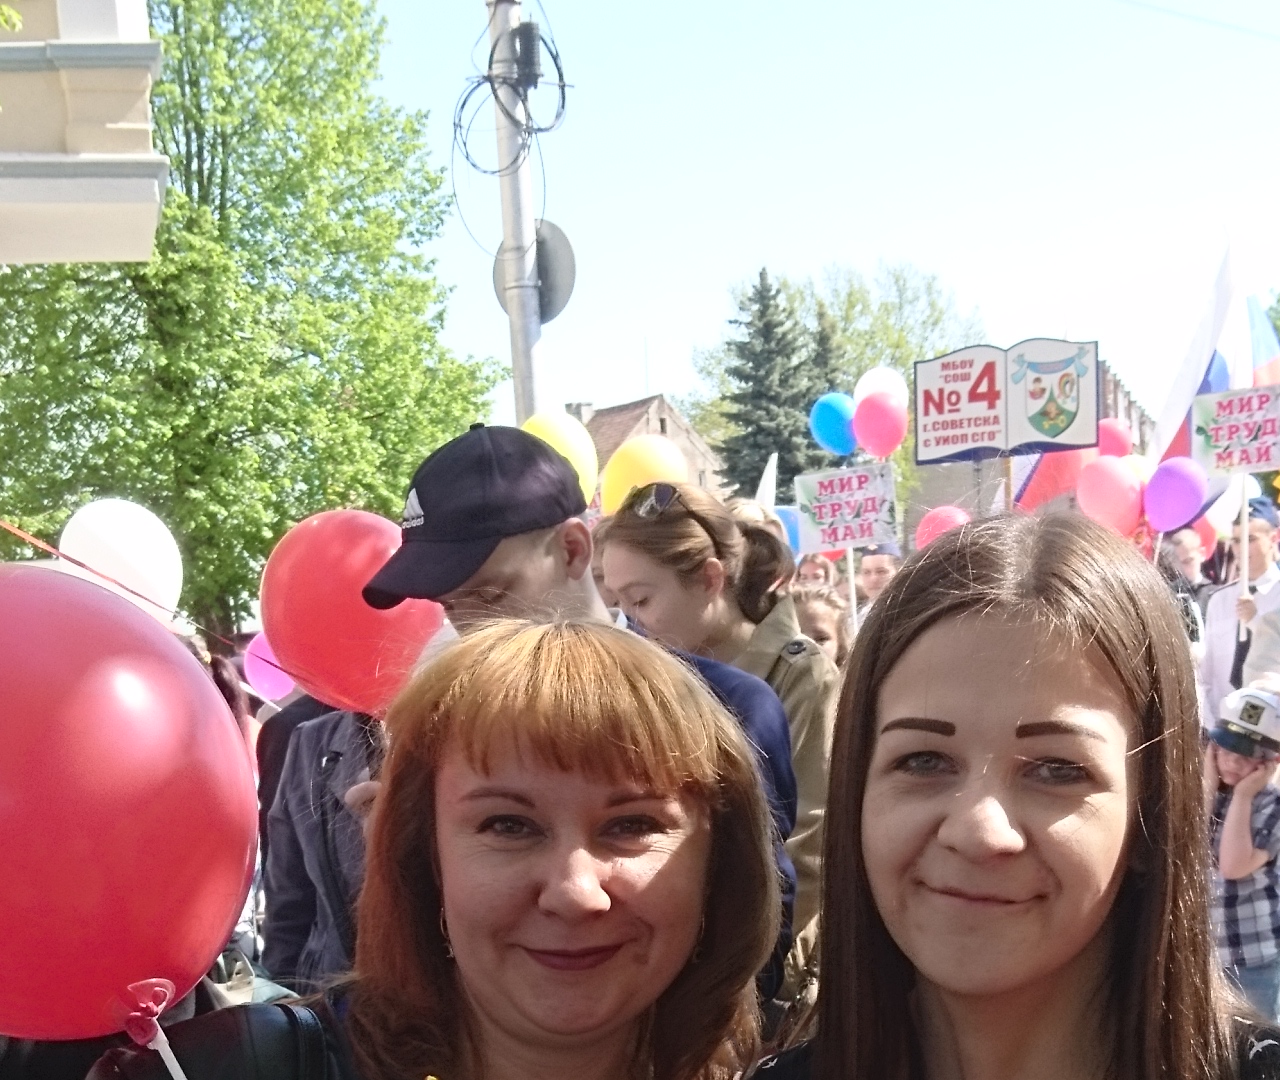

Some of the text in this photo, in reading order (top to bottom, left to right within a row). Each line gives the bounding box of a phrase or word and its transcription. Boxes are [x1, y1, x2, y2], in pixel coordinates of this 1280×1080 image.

[941, 359, 974, 372] МБОУ
[1215, 393, 1271, 418] МИР
[934, 433, 969, 447] УИОП
[1210, 418, 1278, 443] ТРУД
[1215, 440, 1273, 469] МАЙ
[817, 474, 870, 497] МИР
[813, 496, 880, 521] ТРУД
[820, 518, 875, 544] МАЙ
